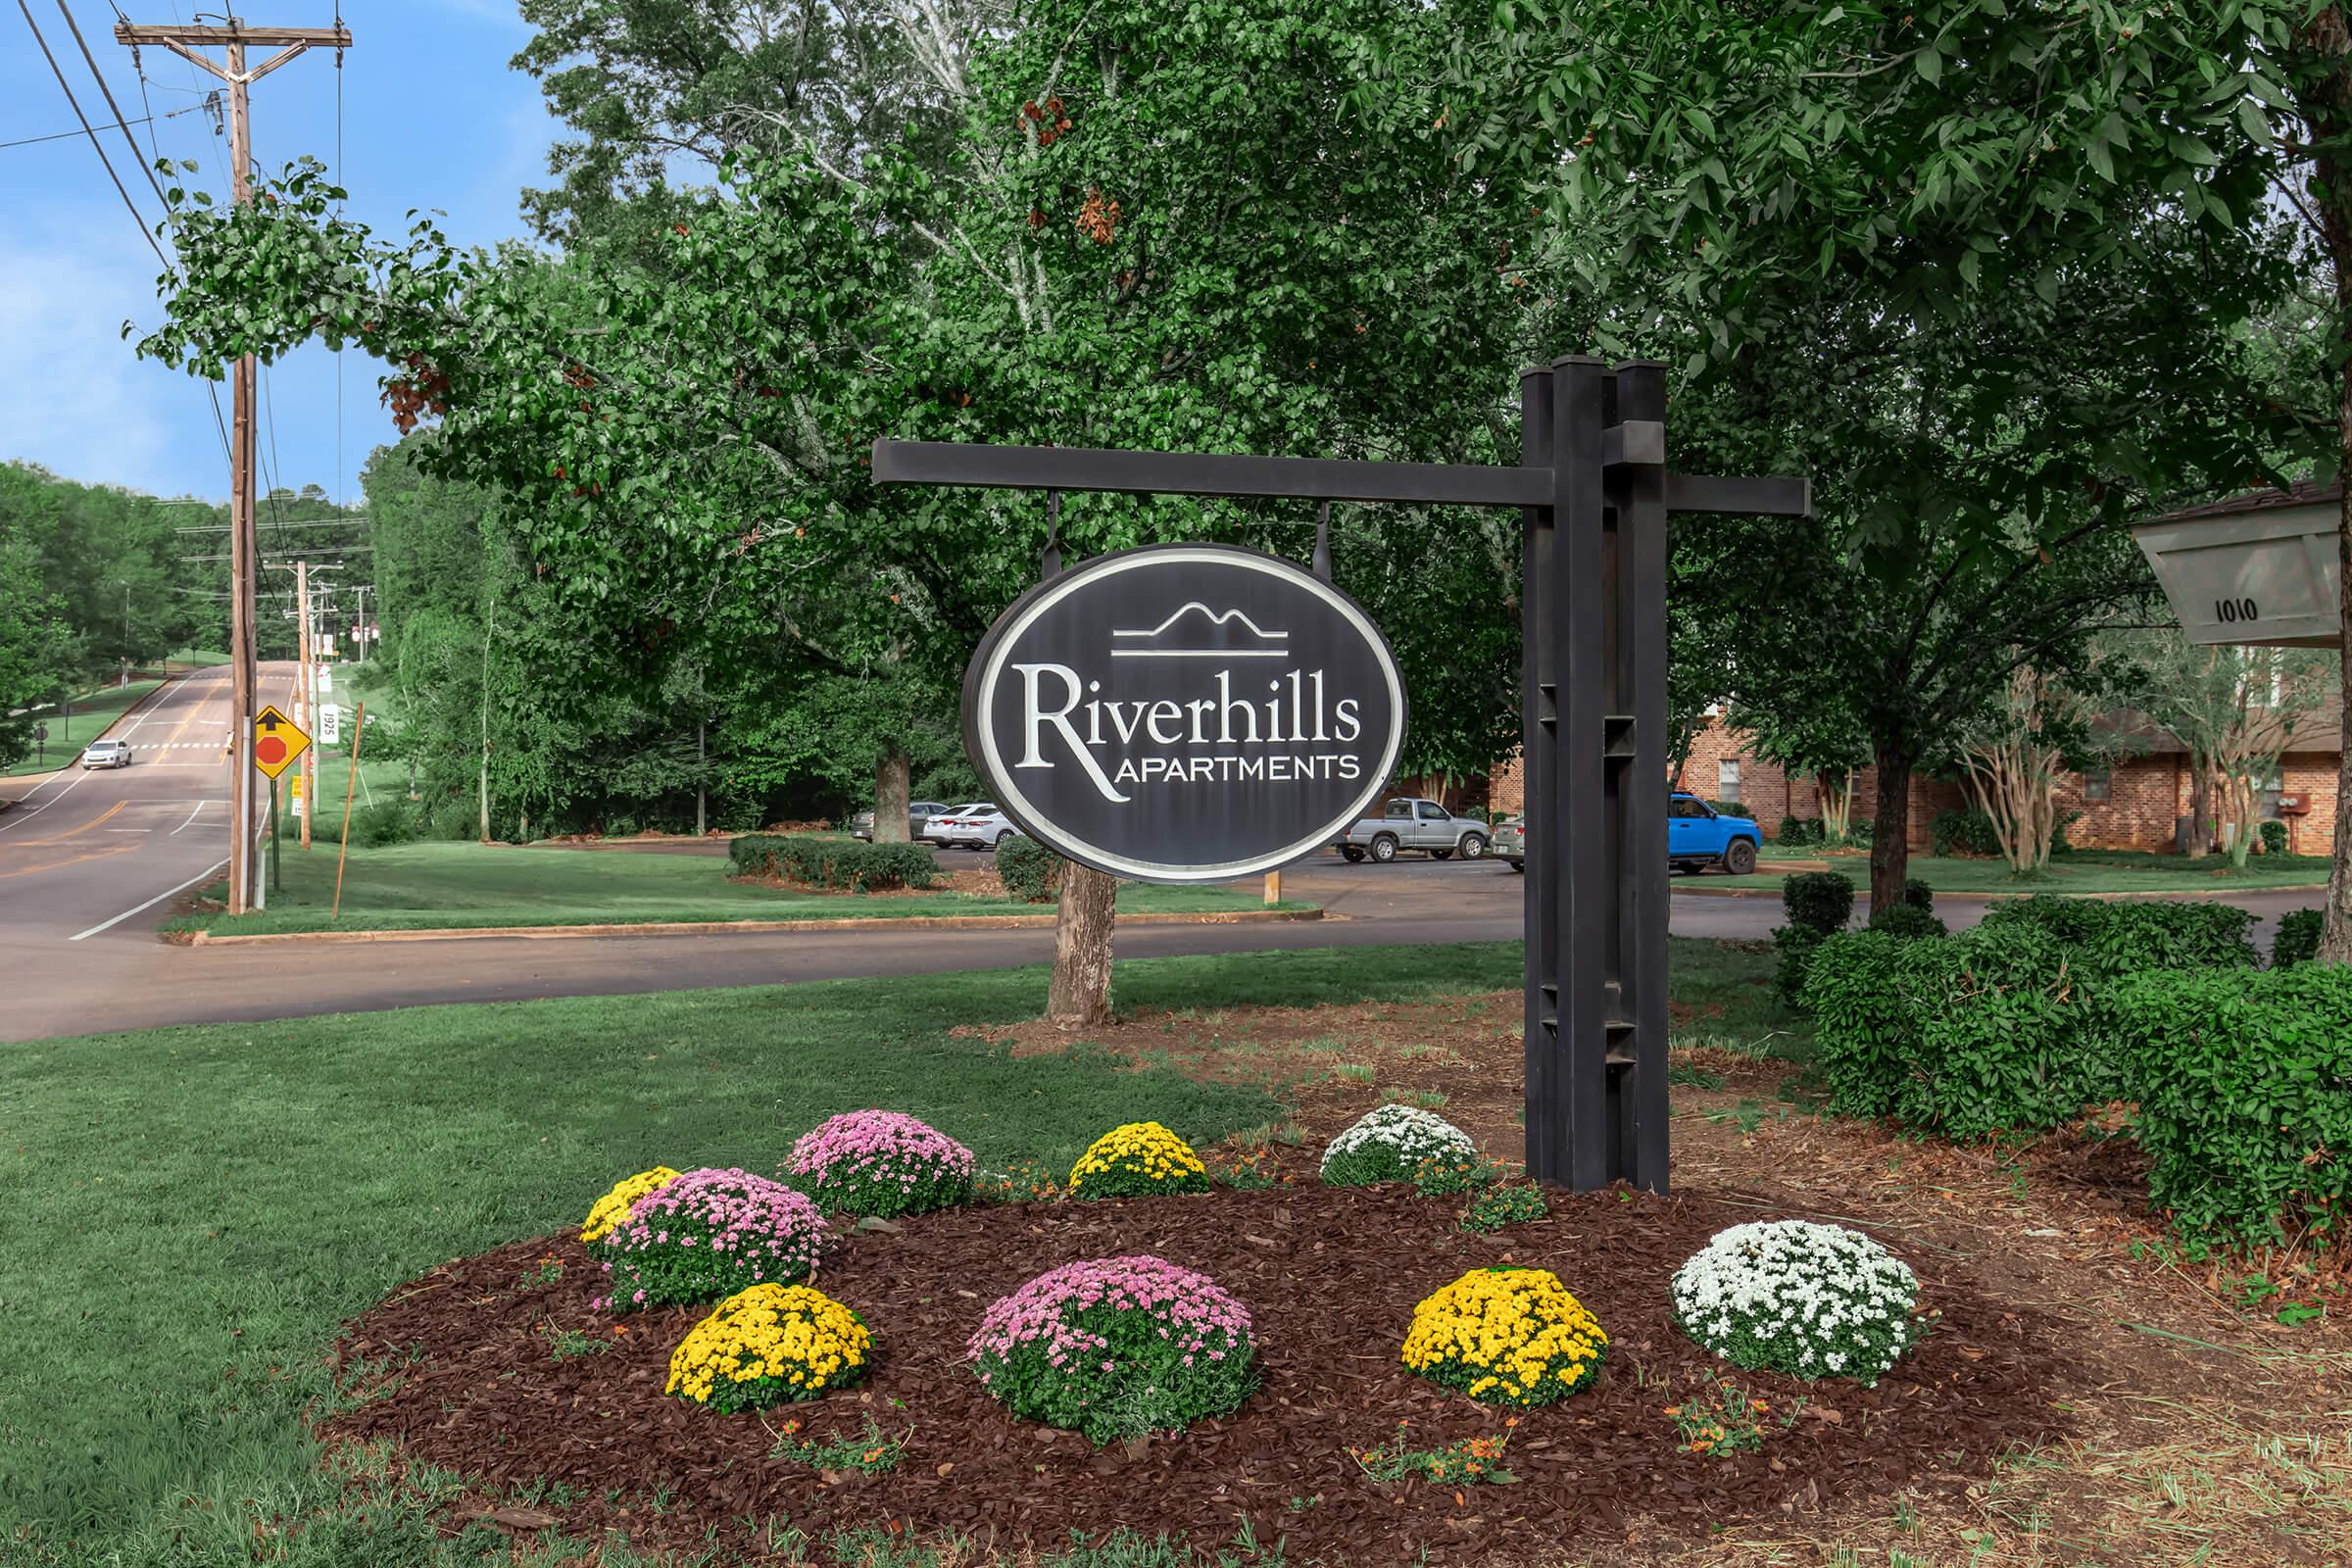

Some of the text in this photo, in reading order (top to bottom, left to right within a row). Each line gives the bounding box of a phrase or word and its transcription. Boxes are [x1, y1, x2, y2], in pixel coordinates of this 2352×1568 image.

[2216, 598, 2258, 622] 1010
[1011, 663, 1361, 803] Riverhills
[1113, 754, 1361, 784] APARTMENTS
